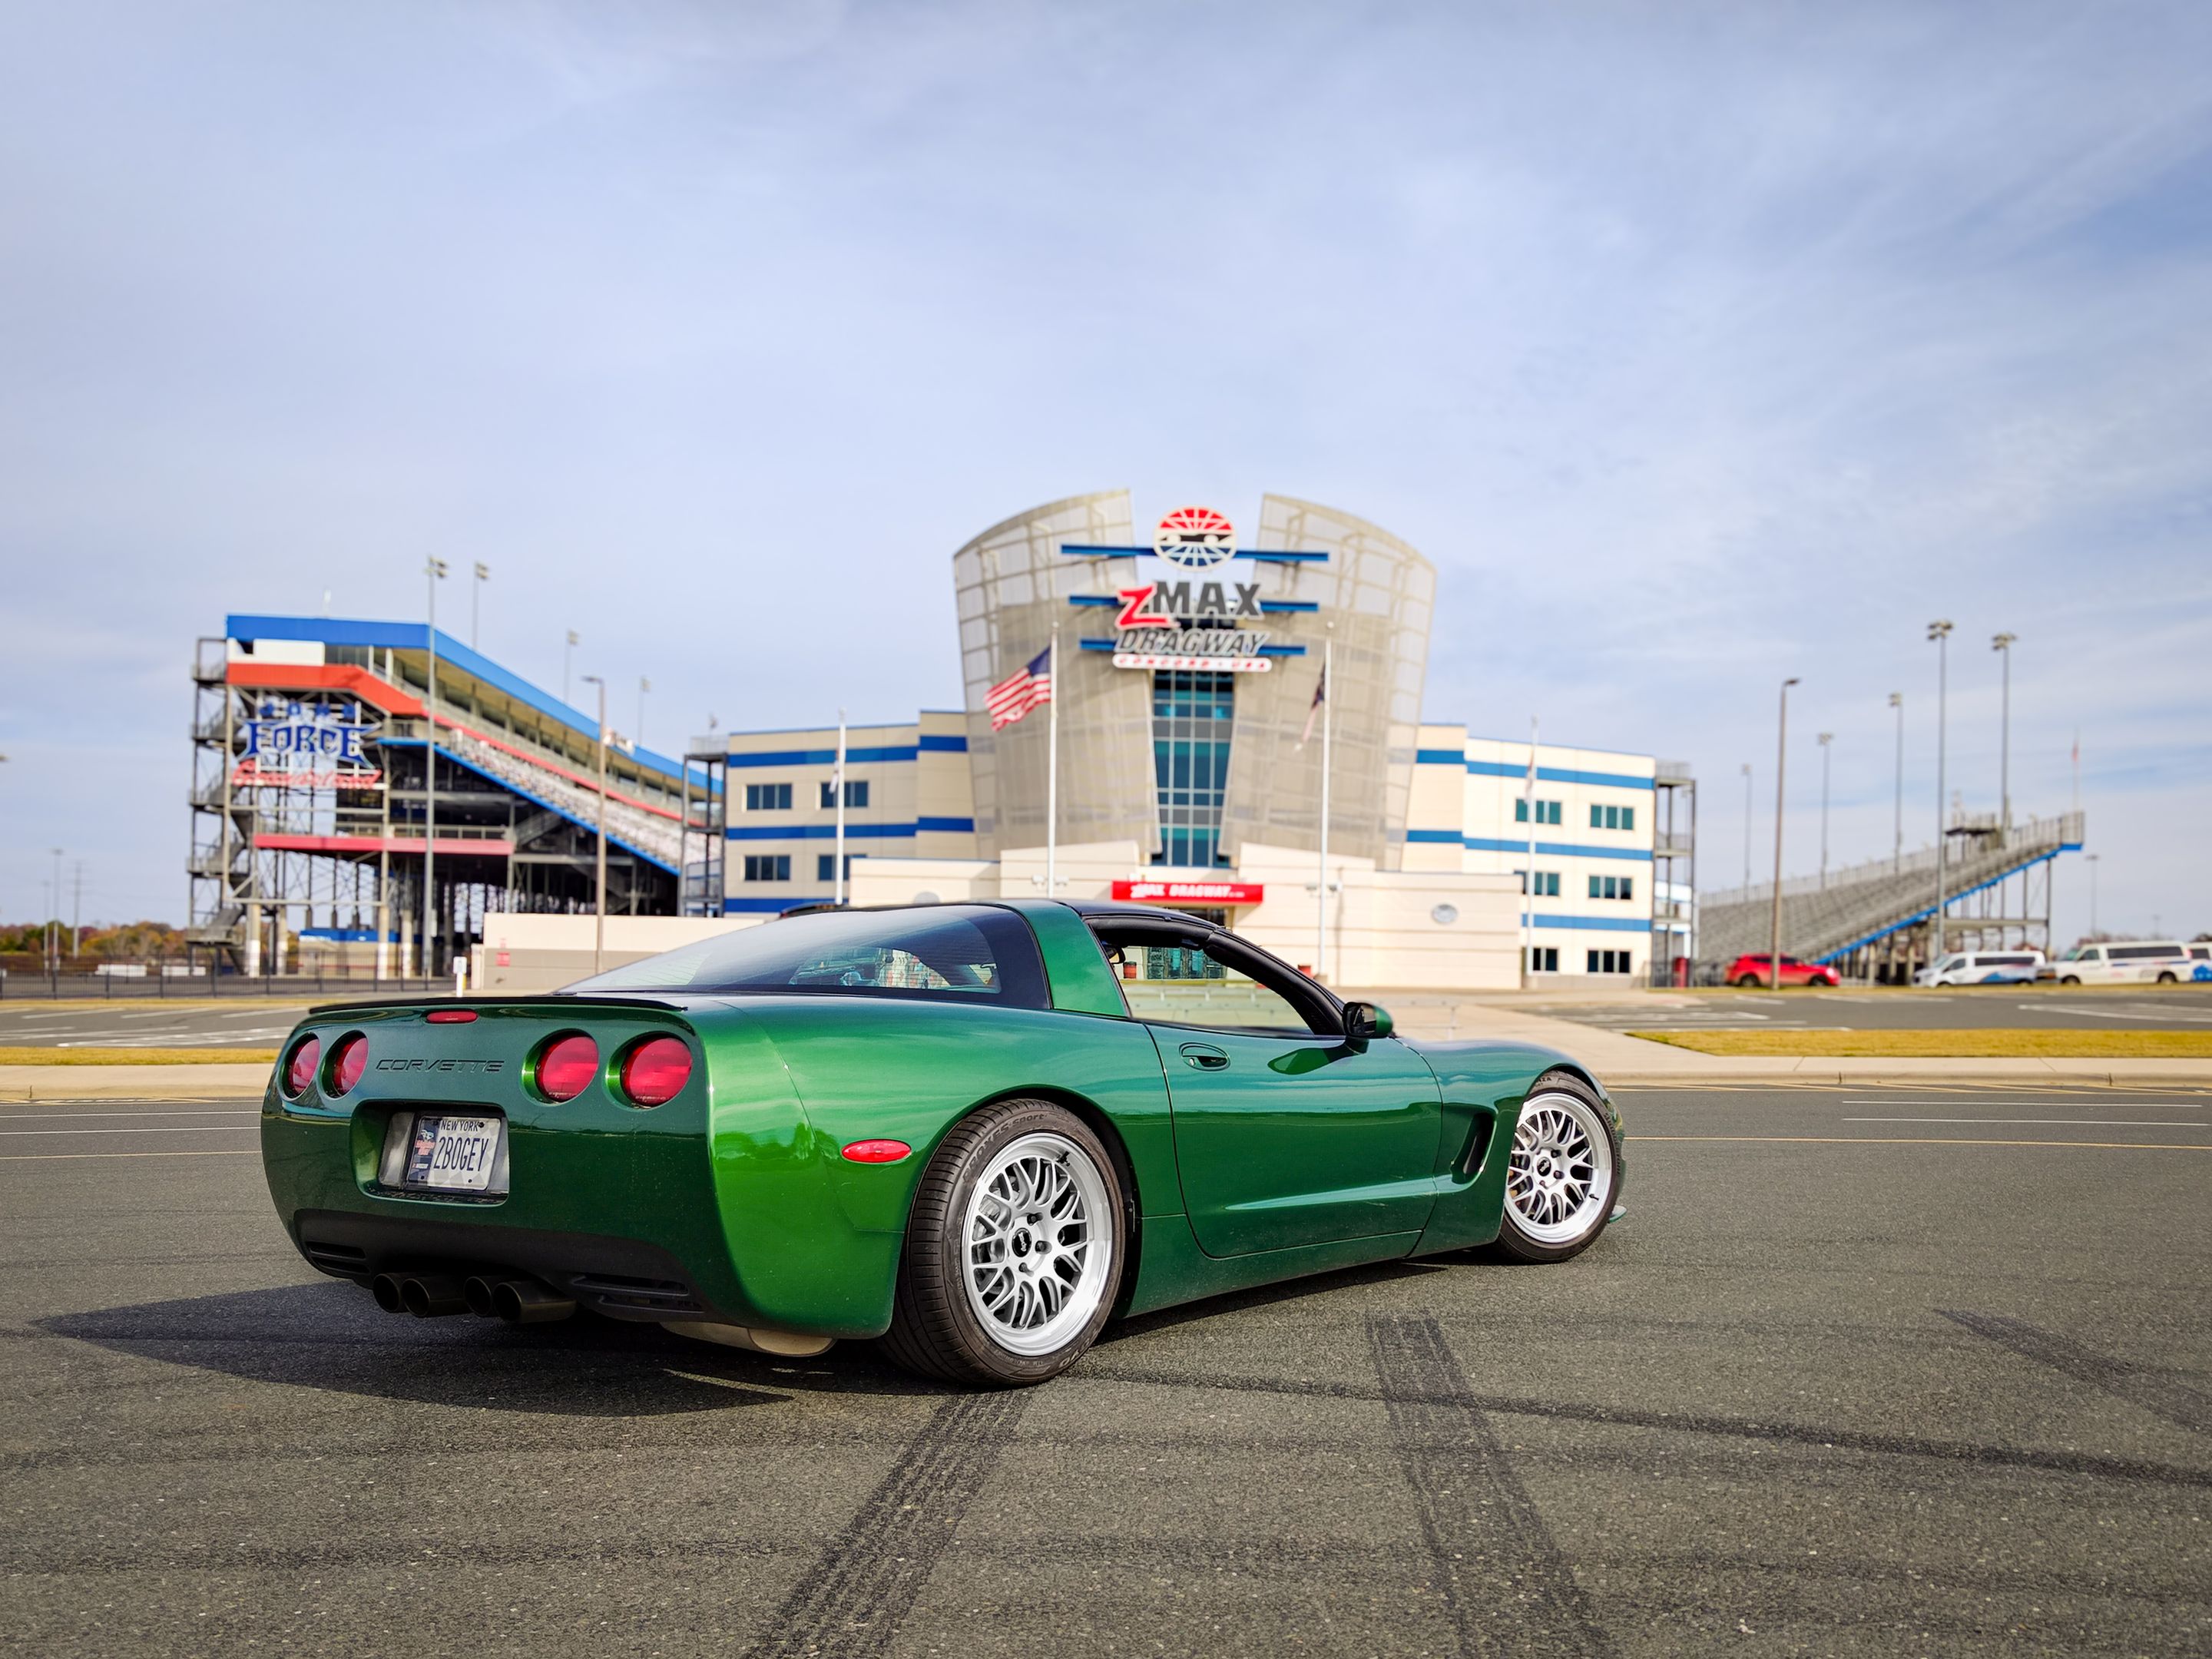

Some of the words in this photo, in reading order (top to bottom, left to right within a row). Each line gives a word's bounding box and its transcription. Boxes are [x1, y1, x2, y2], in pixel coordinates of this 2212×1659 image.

[1117, 629, 1268, 655] DRAGWAY
[238, 720, 379, 768] FORCE
[376, 1059, 505, 1072] CORVETTE
[440, 1120, 458, 1131] NEW
[459, 1121, 479, 1132] YORK
[433, 1136, 489, 1172] 2BOGEY
